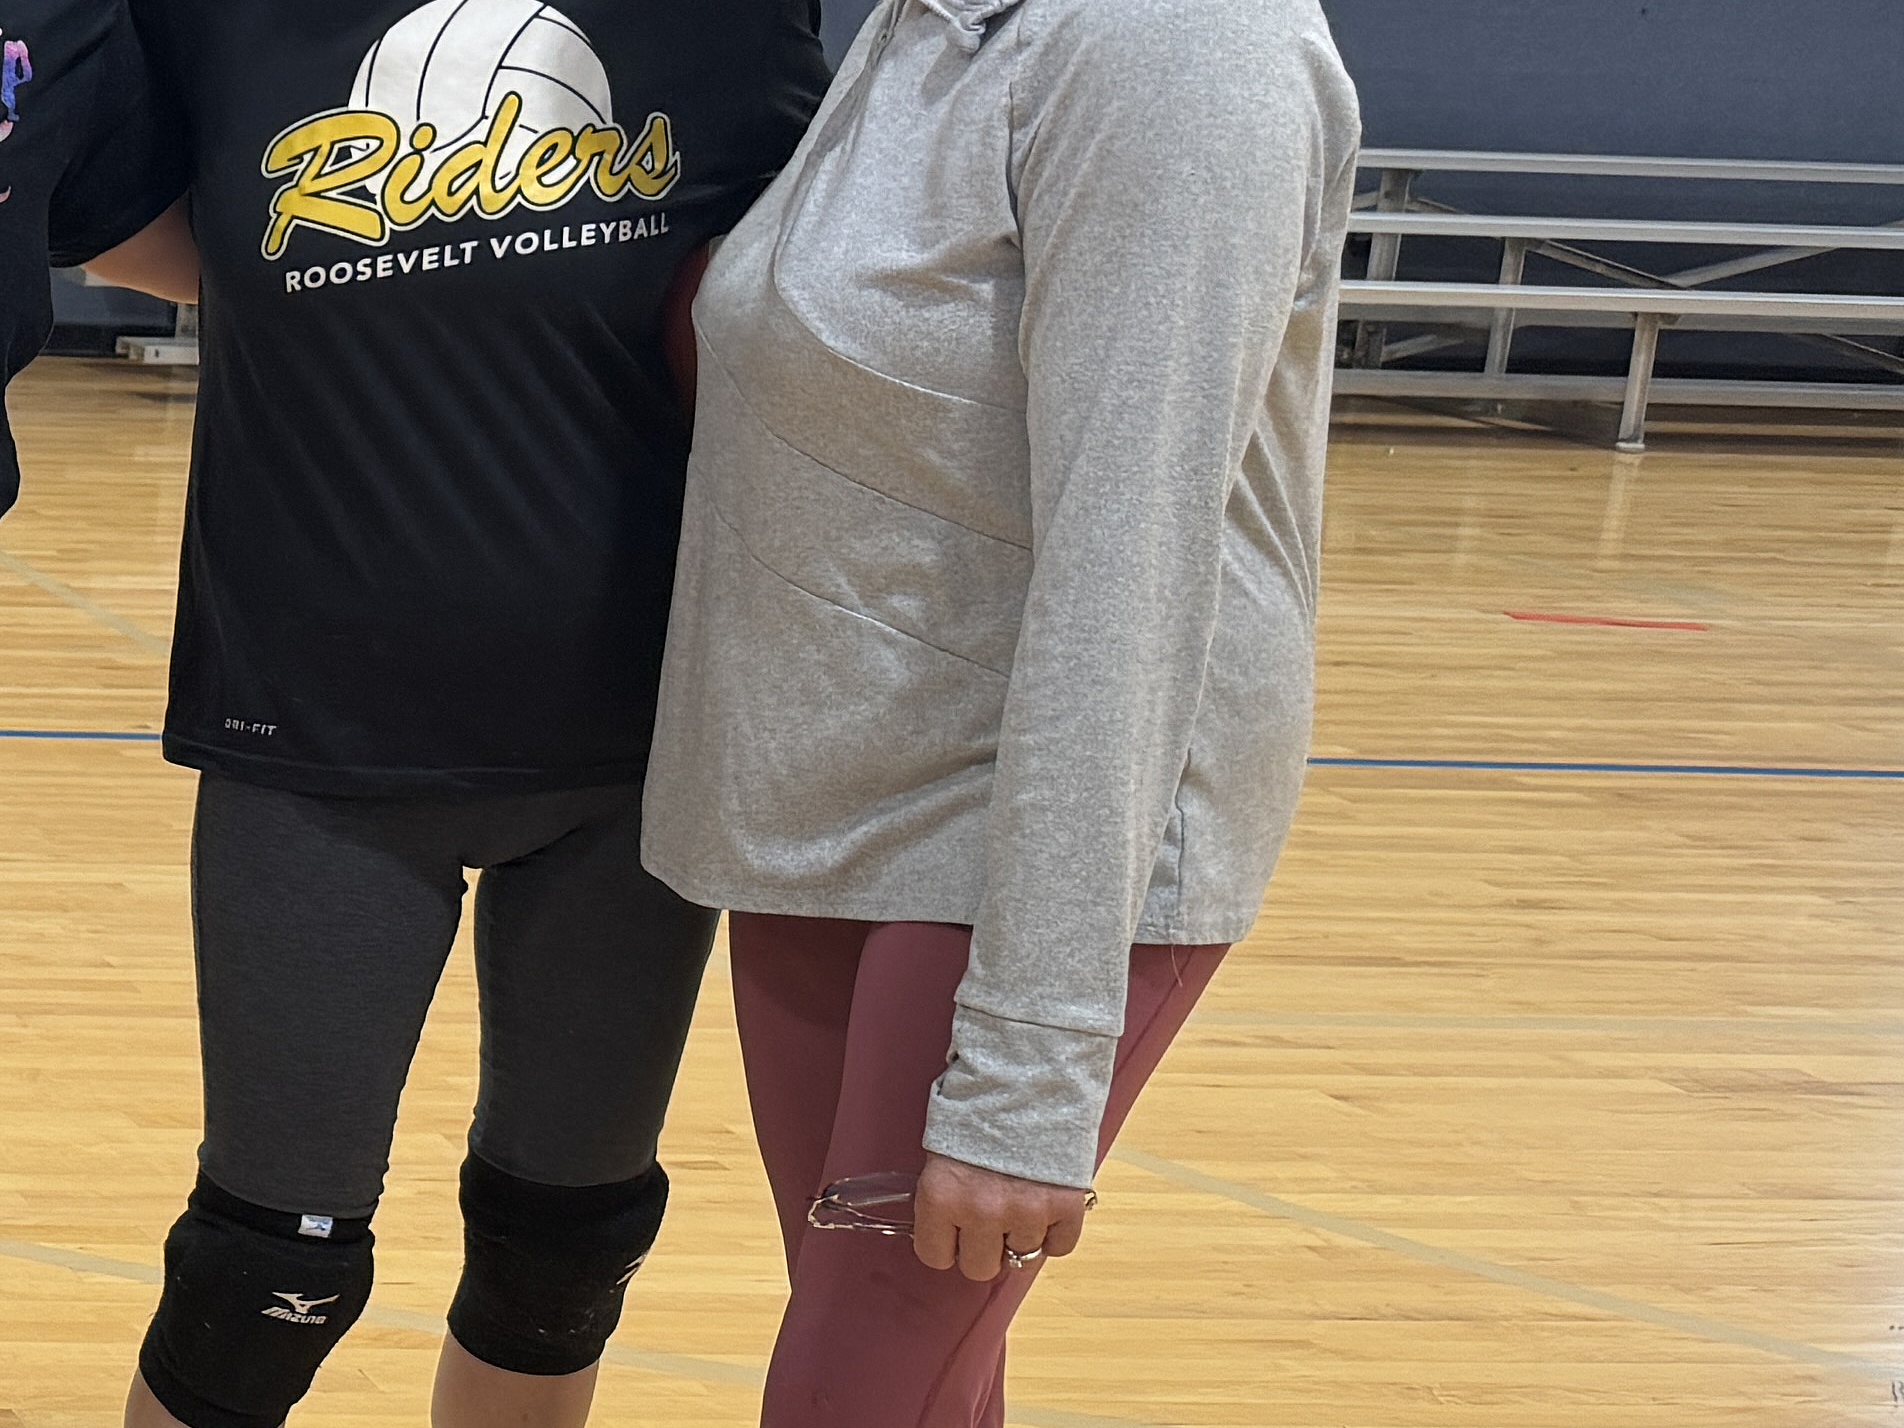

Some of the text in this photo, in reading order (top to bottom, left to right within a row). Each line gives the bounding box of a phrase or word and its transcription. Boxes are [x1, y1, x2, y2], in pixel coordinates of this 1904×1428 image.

[261, 90, 681, 261] Riders
[285, 212, 670, 294] ROOSEVELT VOLLEYBALL
[224, 718, 277, 736] DRI-FIT
